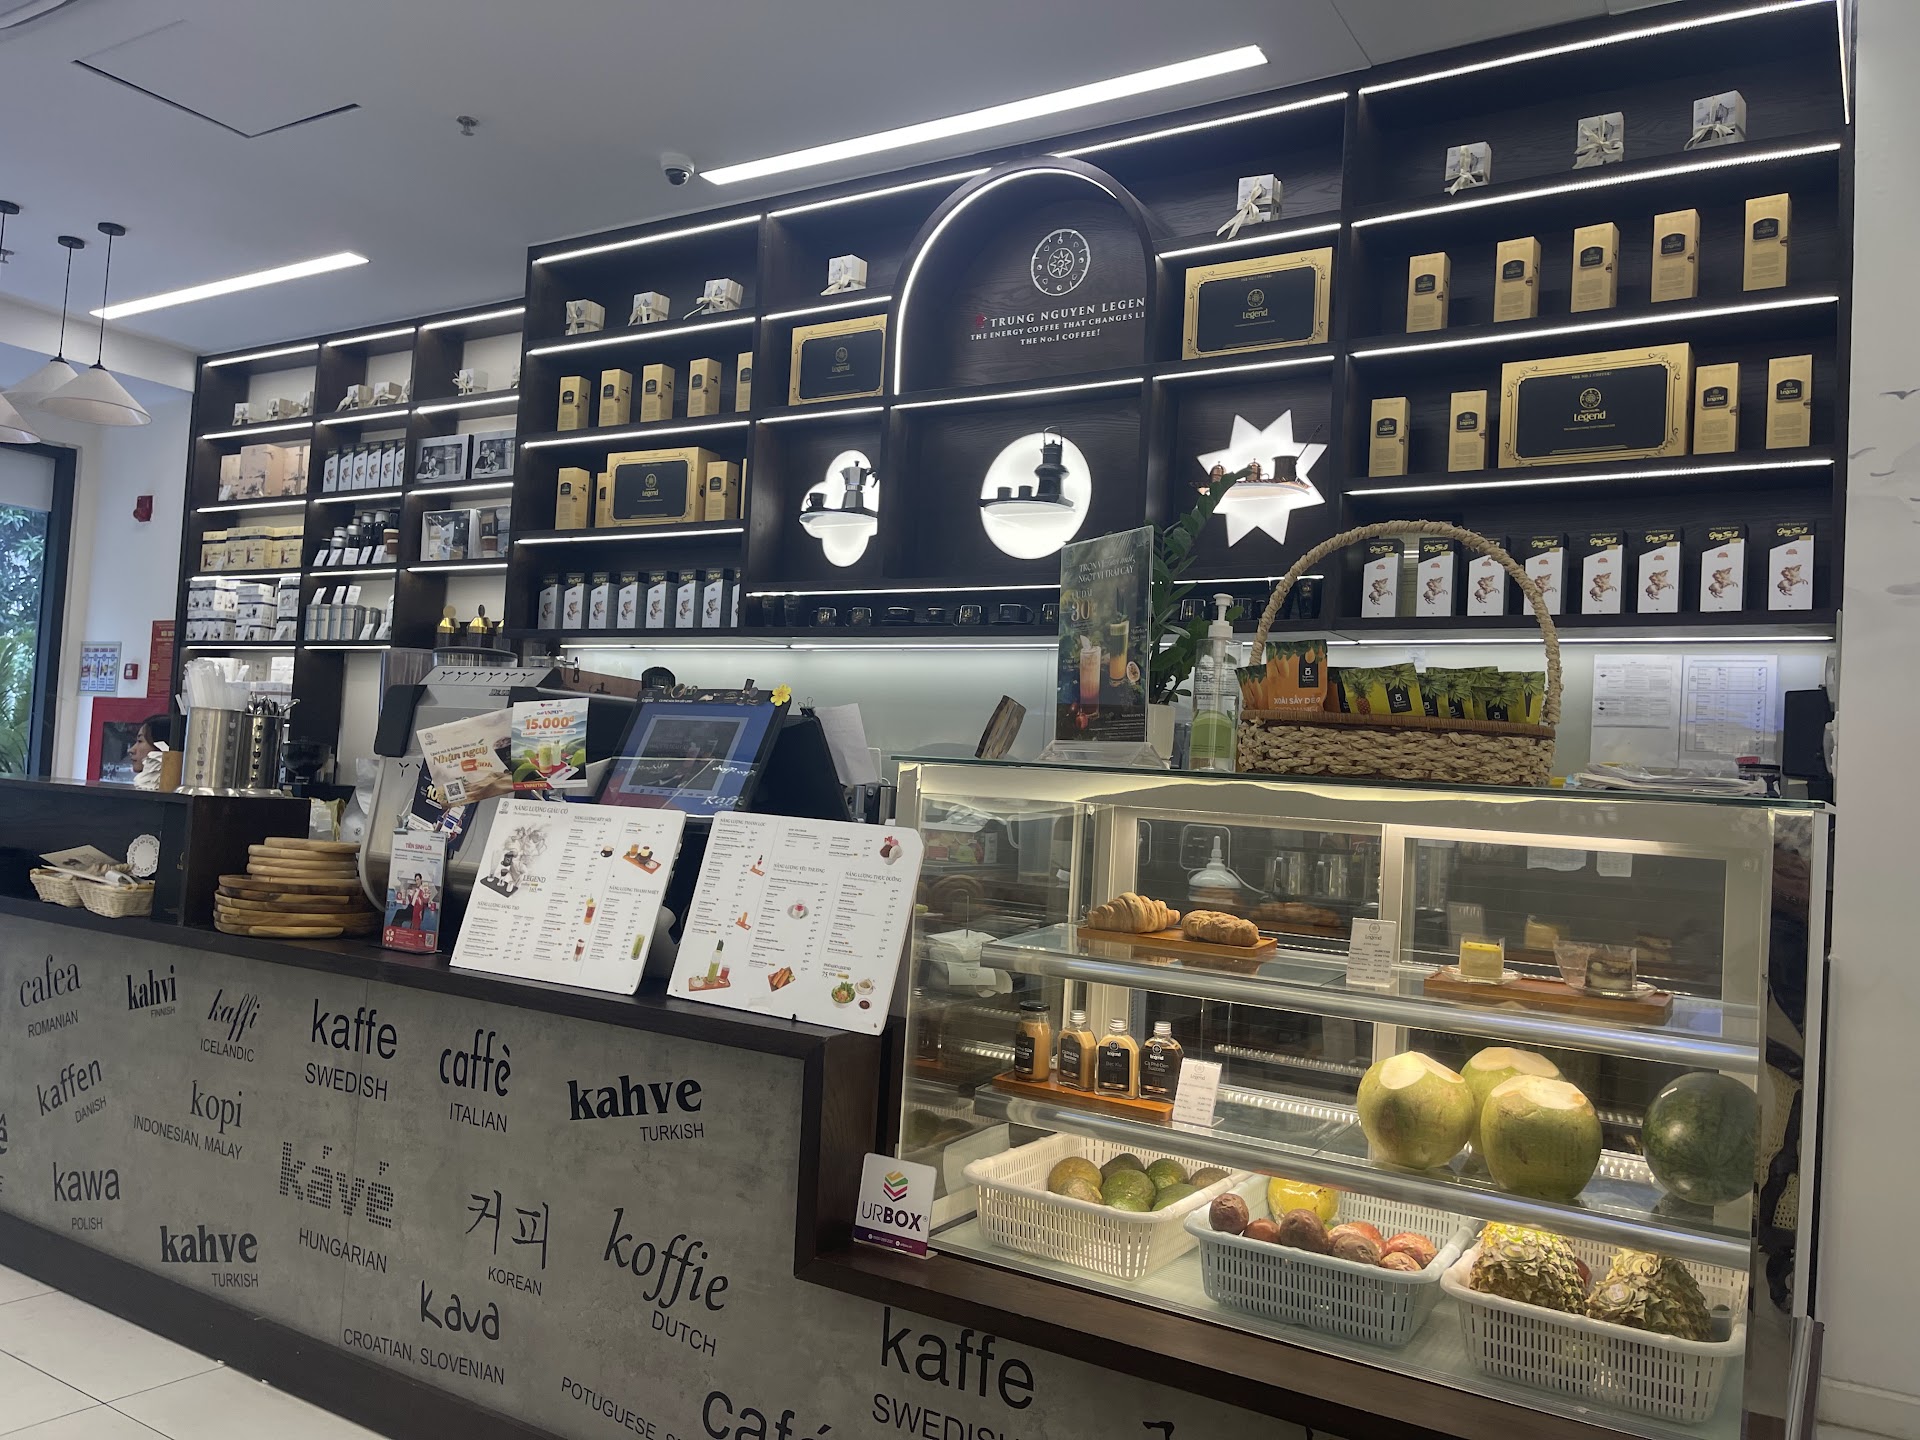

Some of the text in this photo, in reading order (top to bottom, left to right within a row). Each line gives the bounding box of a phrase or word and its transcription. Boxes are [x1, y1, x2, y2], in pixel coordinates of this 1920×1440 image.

[970, 332, 987, 340] THE
[990, 328, 1024, 339] ENERGY
[1027, 323, 1060, 334] COFFEE
[1063, 319, 1087, 329] THAT
[1089, 312, 1133, 326] CHANGES
[990, 313, 1035, 328] TRUNG
[1040, 304, 1096, 321] NGUYEN
[1242, 308, 1268, 319] Legend
[1020, 336, 1038, 346] THE
[1062, 329, 1101, 341] COFFEE!
[1573, 411, 1606, 422] Legend
[523, 874, 546, 884] LEGEND
[19, 954, 81, 1008] cafea
[126, 965, 177, 1010] kahvi
[28, 1009, 79, 1038] ROMANIAN
[150, 1006, 176, 1018] FINNISH
[208, 989, 261, 1042] kaffi
[311, 999, 398, 1059] kaffe
[200, 1037, 255, 1063] ICELANDIC
[440, 1029, 512, 1097] caffè
[36, 1059, 102, 1117] kaffen
[304, 1062, 388, 1102] SWEDISH
[567, 1075, 703, 1121] kahve
[75, 1096, 107, 1124] DANISH
[190, 1080, 243, 1135] kopi
[448, 1103, 508, 1133] ITALIAN
[204, 1134, 243, 1160] MALAY
[640, 1122, 704, 1142] TURKISH
[52, 1162, 121, 1202] kawa
[279, 1141, 394, 1229] kávé
[71, 1217, 103, 1230] POLISH
[159, 1224, 258, 1263] kahve
[466, 1189, 549, 1270] 커피
[299, 1228, 388, 1274] HUNGARIAN
[604, 1207, 730, 1312] koffie
[211, 1273, 259, 1288] TURKISH
[487, 1266, 543, 1297] KOREAN
[420, 1280, 500, 1341] kava
[651, 1311, 717, 1357] DUTCH
[343, 1328, 505, 1386] CROATIAN, SLOVENIAN
[880, 1306, 1035, 1410] kaffe
